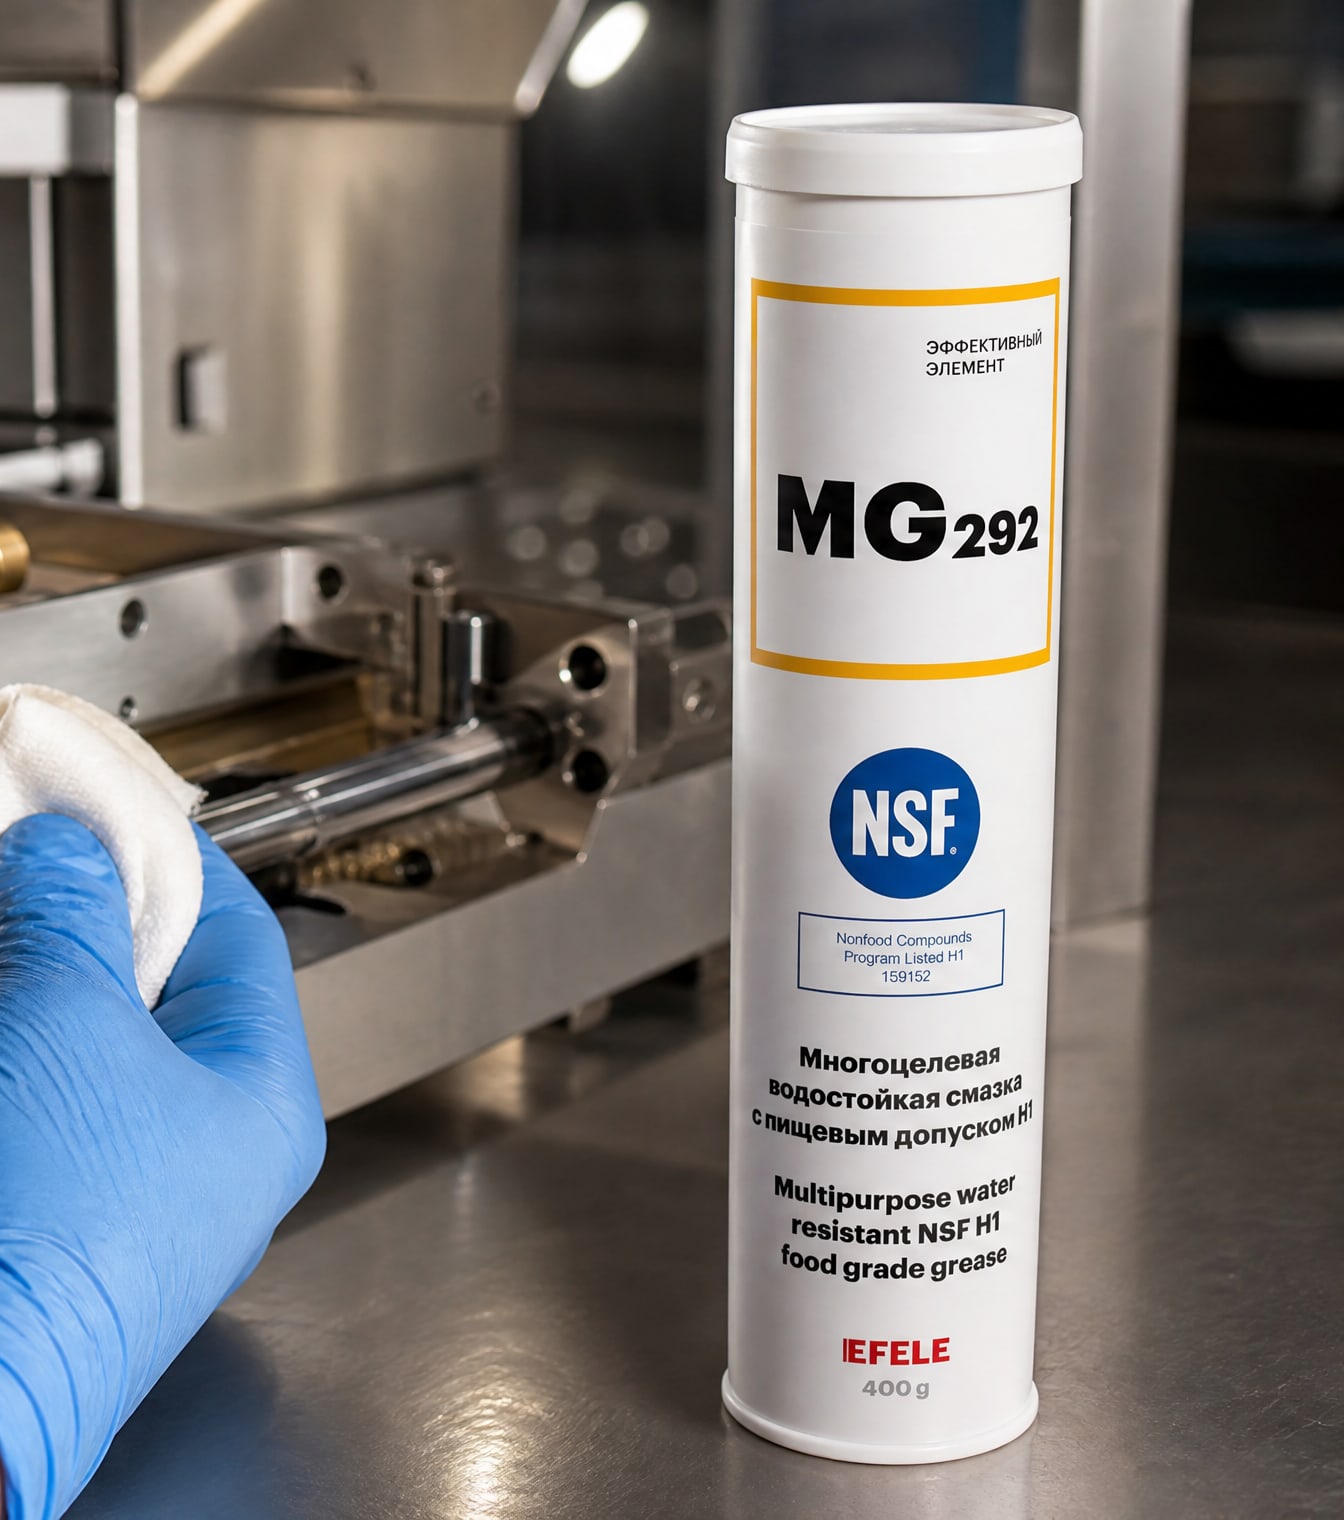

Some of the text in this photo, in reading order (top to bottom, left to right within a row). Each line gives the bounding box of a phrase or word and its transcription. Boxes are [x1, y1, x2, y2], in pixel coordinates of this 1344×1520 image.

[926, 328, 1042, 355] ЭФФЕКТИВНЫЙ
[925, 358, 1005, 376] ЭЛЕМЕНТ
[836, 931, 972, 948] Nonfood Compounds
[844, 949, 964, 966] Program Listed H1
[882, 969, 931, 983] 159152
[799, 1046, 1000, 1077] Многоцелевая
[769, 1075, 1022, 1110] водостойкая смазка
[752, 1100, 1032, 1149] с пищевым допуском H1
[774, 1175, 1015, 1215] Multipurpose water
[791, 1211, 1000, 1245] resistant NSF H1
[781, 1244, 1007, 1282] food grade grease
[862, 1380, 929, 1399] 400 g
